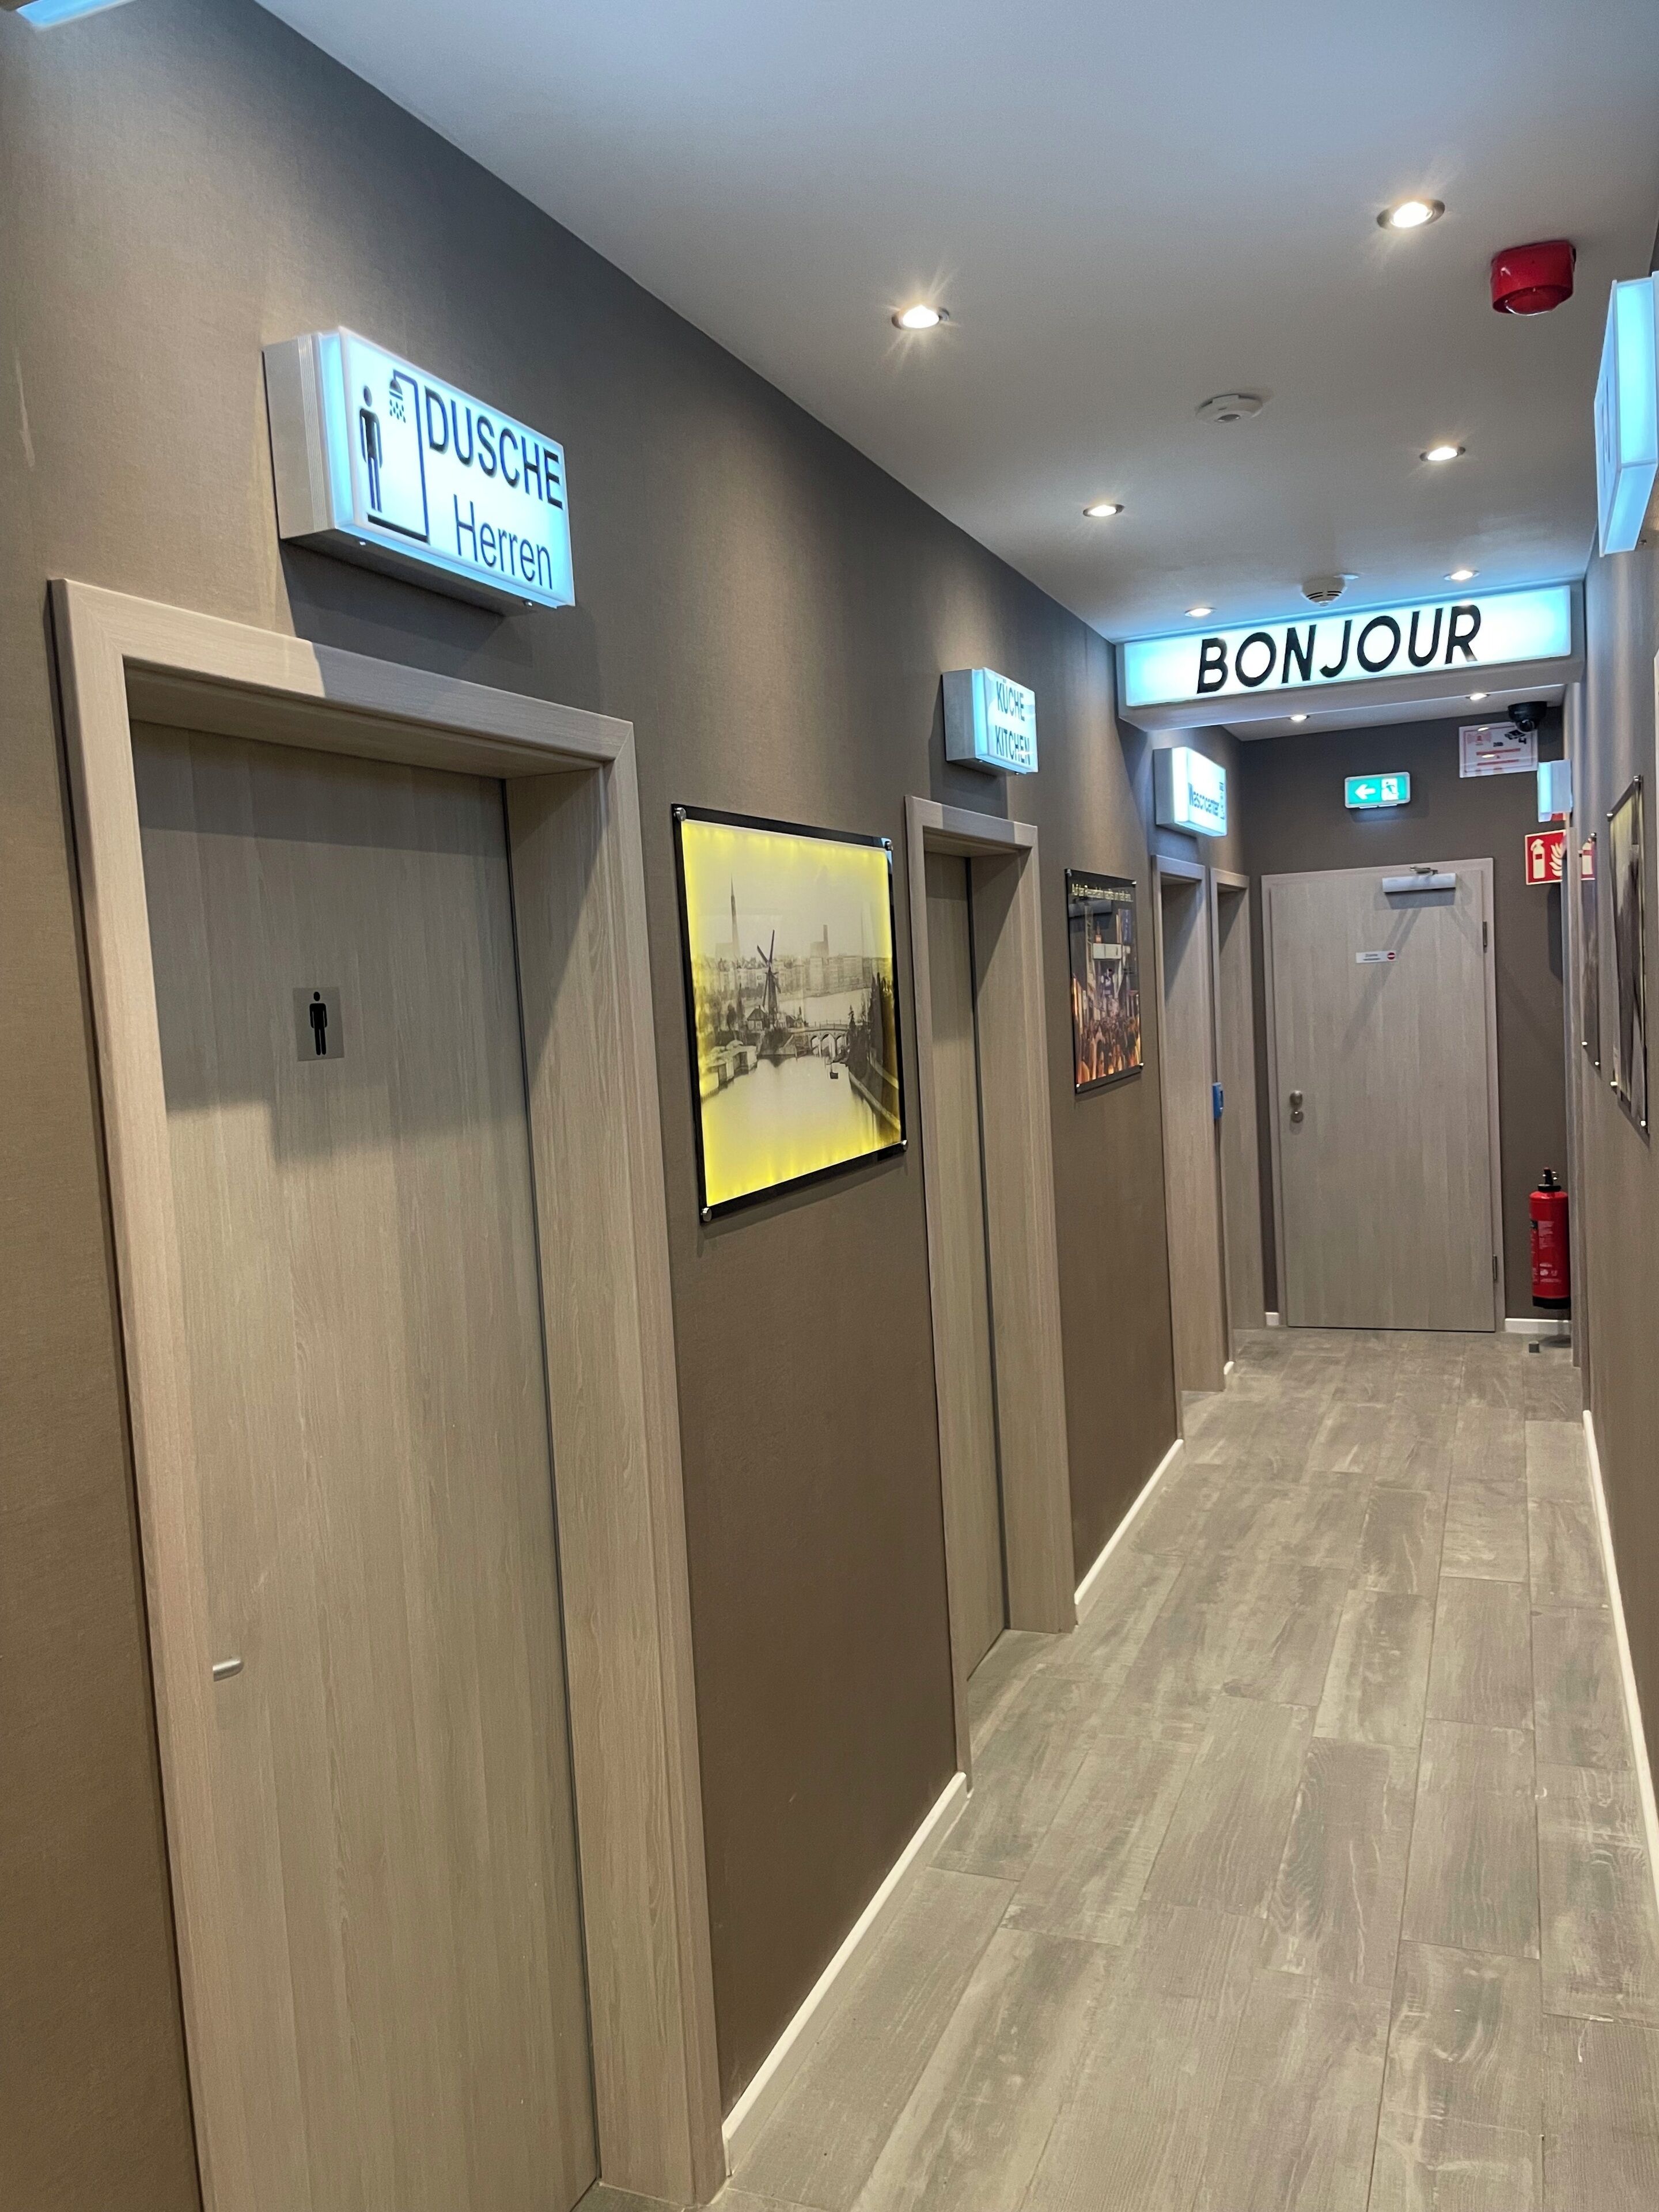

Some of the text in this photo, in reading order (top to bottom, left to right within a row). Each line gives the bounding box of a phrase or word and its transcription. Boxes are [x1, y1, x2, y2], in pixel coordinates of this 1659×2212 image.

[424, 386, 564, 511] DUSCHE
[453, 494, 553, 590] Herren
[1196, 604, 1481, 695] BONJOUR
[995, 725, 1031, 765] KITCHEN
[996, 680, 1025, 721] KÜCHE
